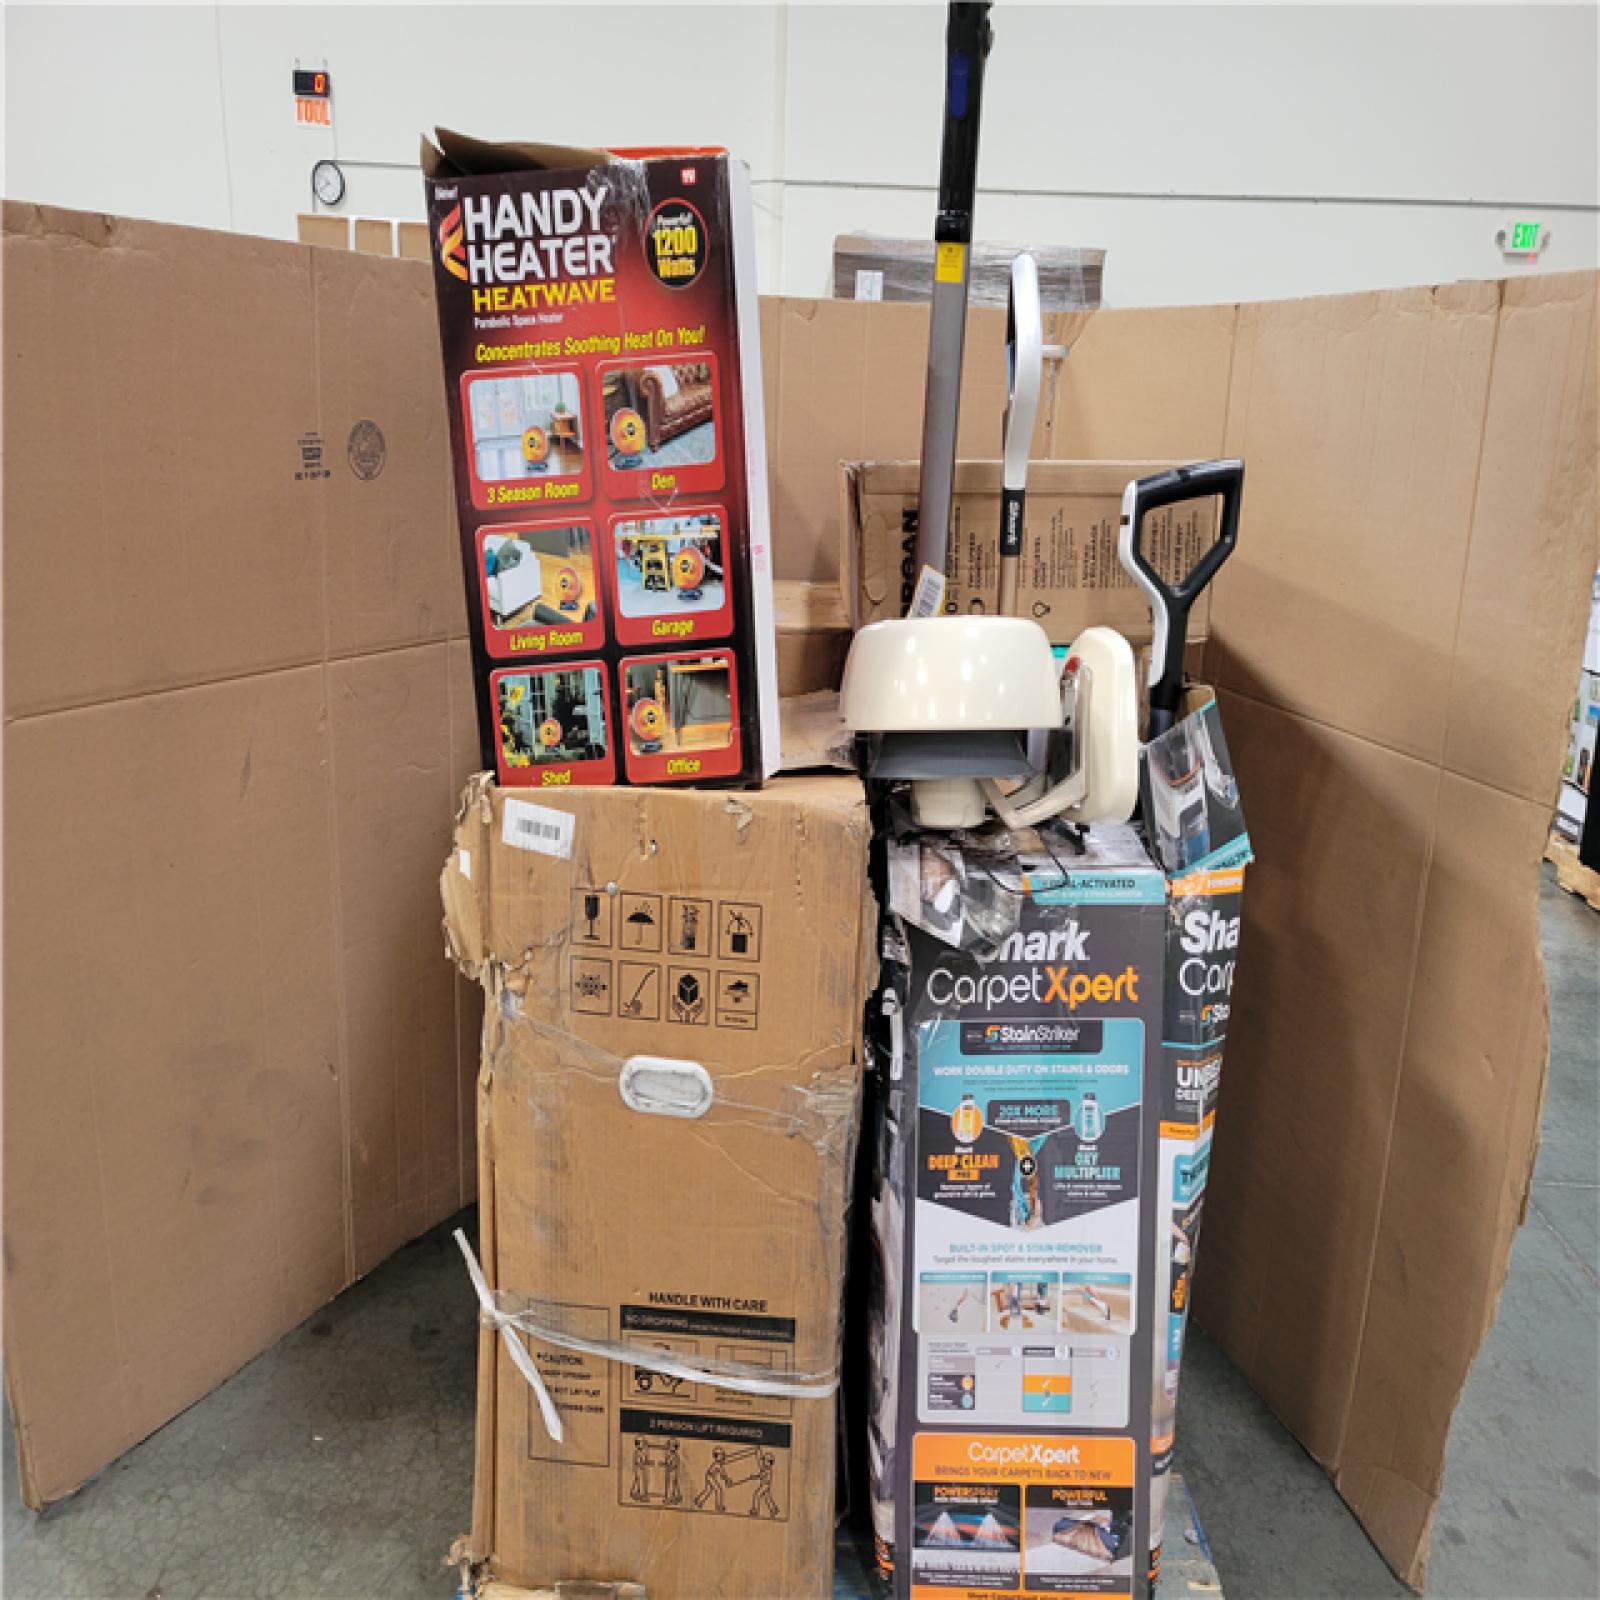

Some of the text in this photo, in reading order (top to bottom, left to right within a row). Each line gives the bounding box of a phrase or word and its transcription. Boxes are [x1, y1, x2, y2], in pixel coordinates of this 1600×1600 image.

[464, 187, 608, 241] HANDY
[652, 226, 699, 256] 1200
[1512, 222, 1540, 248] EXIT
[467, 235, 614, 285] HEATER
[472, 279, 616, 313] HEATWAVE
[475, 324, 706, 363] Concentrates Soothing Heat On You!
[651, 473, 676, 489] Den
[487, 482, 580, 503] 3 Season Room
[652, 619, 694, 637] Garage
[510, 631, 583, 651] Living Room
[542, 770, 571, 785] Shed
[666, 759, 701, 774] Office
[926, 965, 1139, 1011] CarpetXpert
[1000, 1023, 1081, 1043] StainStriker
[648, 1291, 768, 1313] HANDLE WITH CARE
[967, 1441, 1080, 1467] CarpetXpert
[934, 1466, 1112, 1481] BRINGS YOUR CARPETS BACK TO NEW
